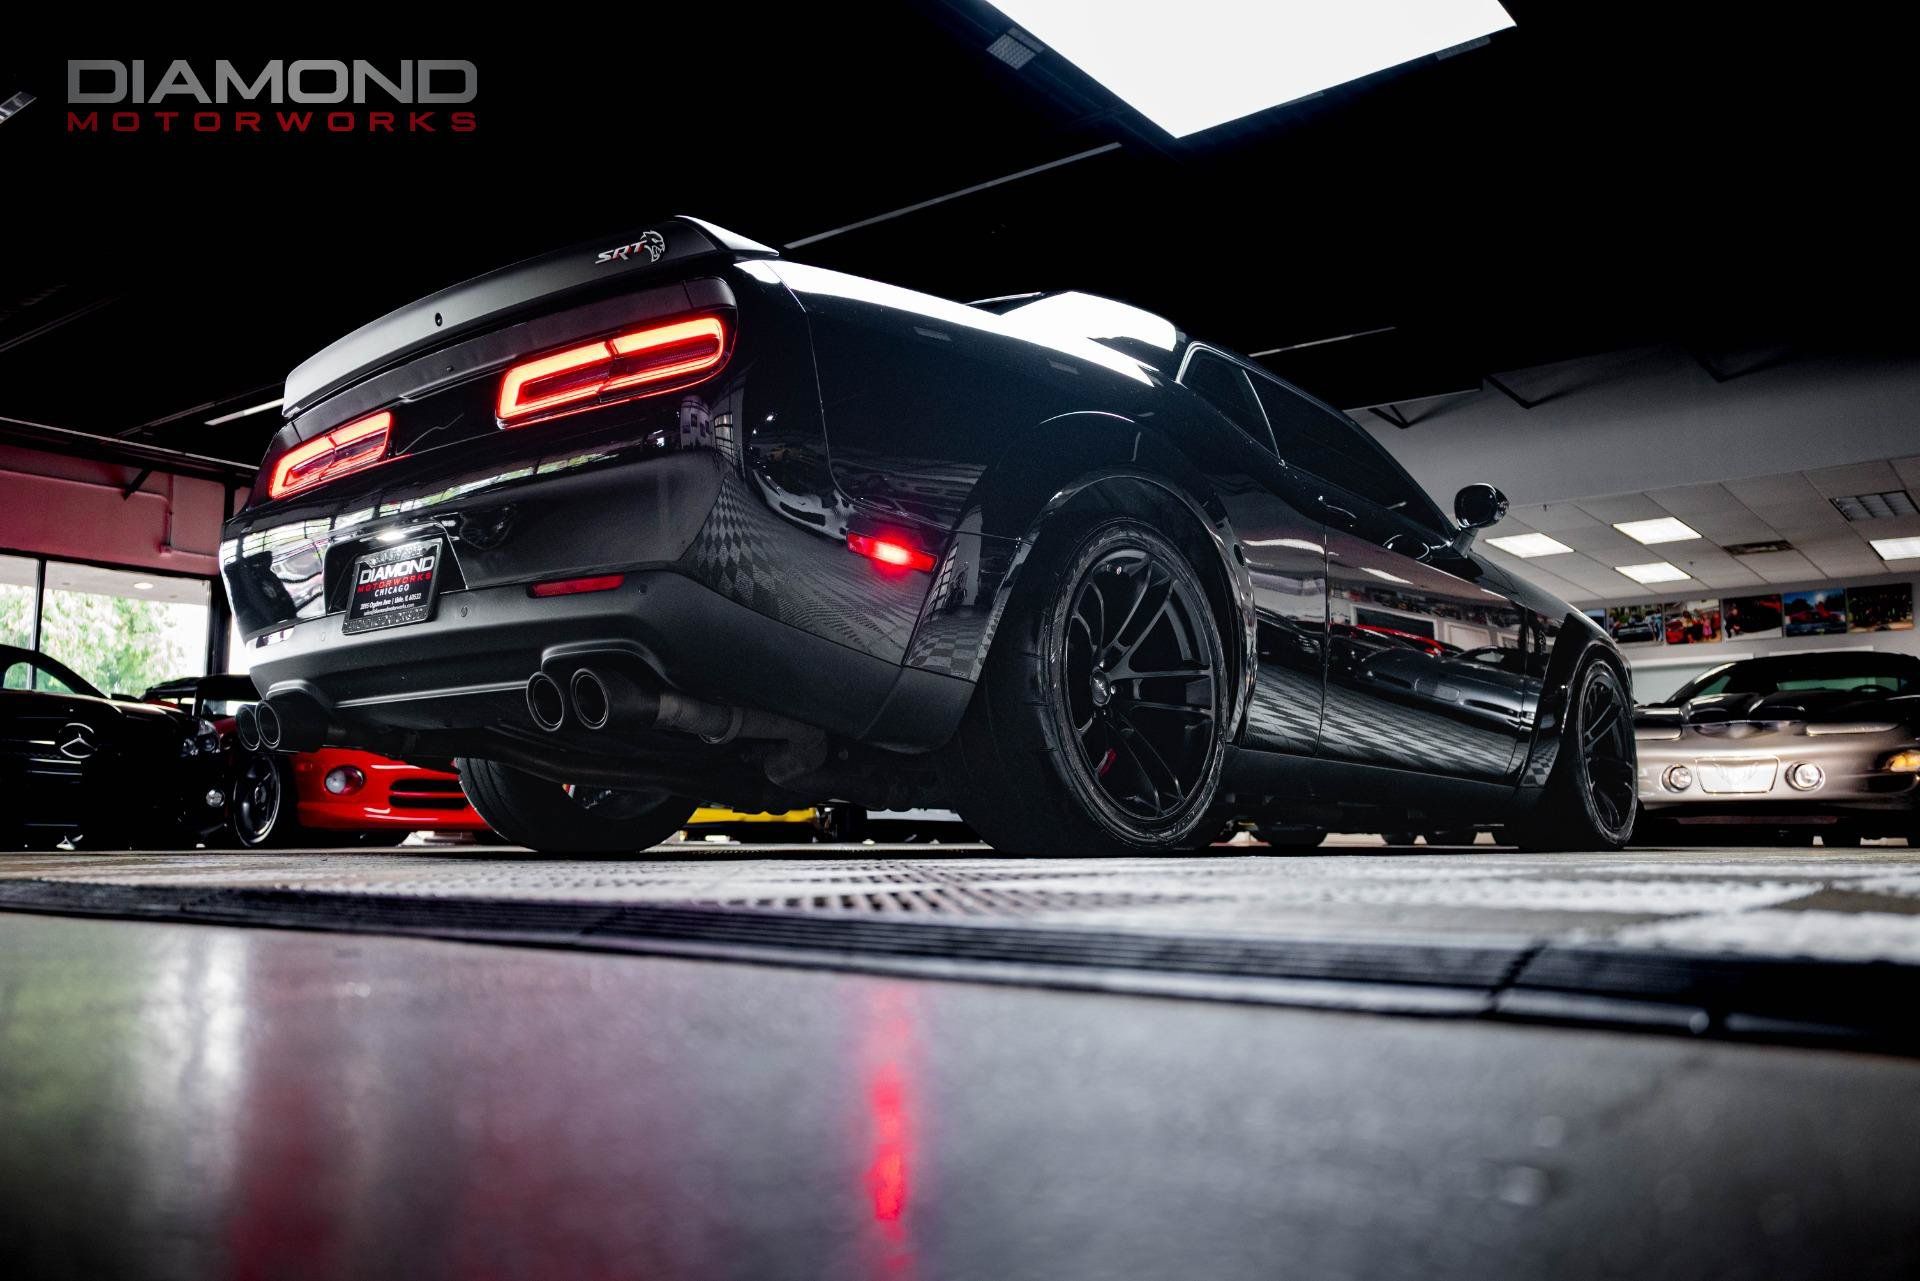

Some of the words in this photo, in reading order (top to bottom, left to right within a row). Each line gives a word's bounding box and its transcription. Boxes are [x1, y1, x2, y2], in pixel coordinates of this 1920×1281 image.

[595, 240, 647, 264] SRT
[359, 556, 435, 585] DIAMOND
[357, 572, 432, 592] MOTORWORKS
[374, 583, 410, 597] CHICAGO
